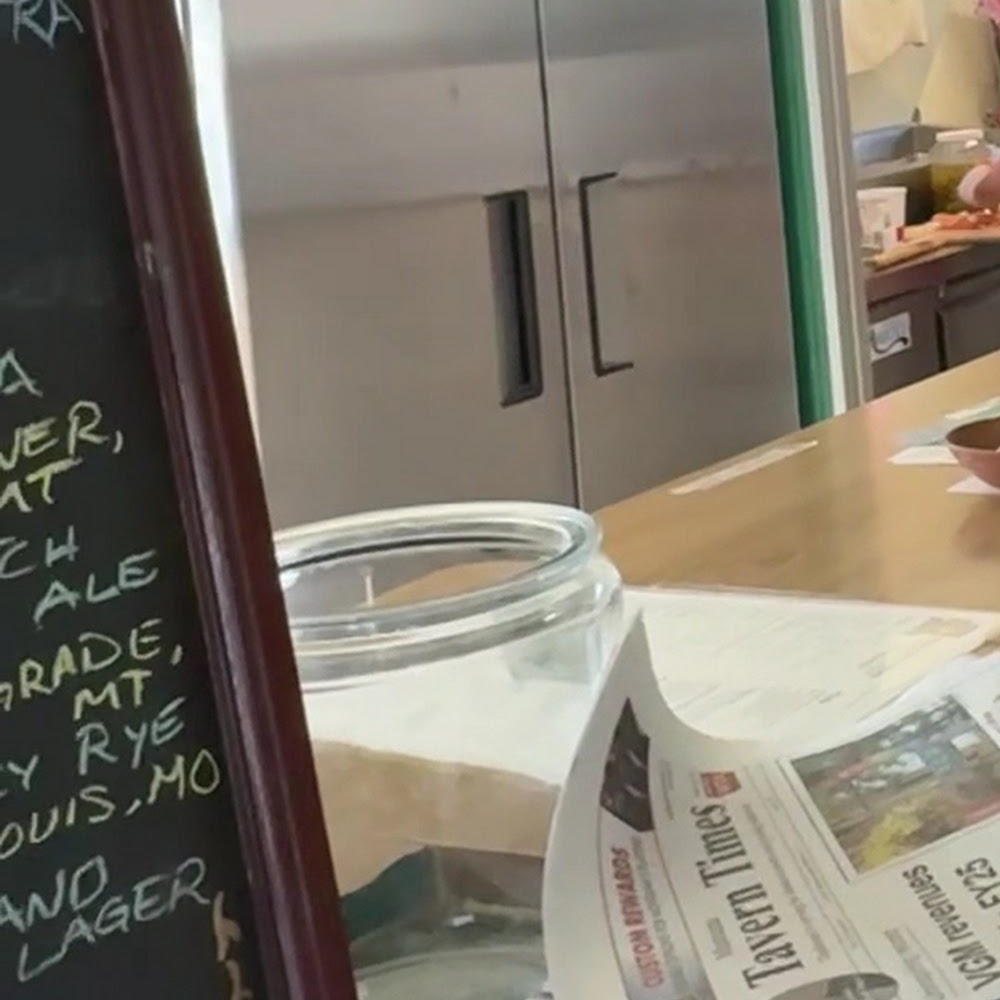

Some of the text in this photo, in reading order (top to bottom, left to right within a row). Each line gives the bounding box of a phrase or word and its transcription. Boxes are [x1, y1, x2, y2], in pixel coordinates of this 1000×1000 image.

[32, 549, 160, 631] ALE
[73, 669, 152, 720] MT
[76, 697, 188, 776] RYE
[690, 804, 754, 889] Times
[16, 857, 211, 983] LAGER
[726, 882, 805, 990] Tavern
[902, 864, 975, 943] revenues
